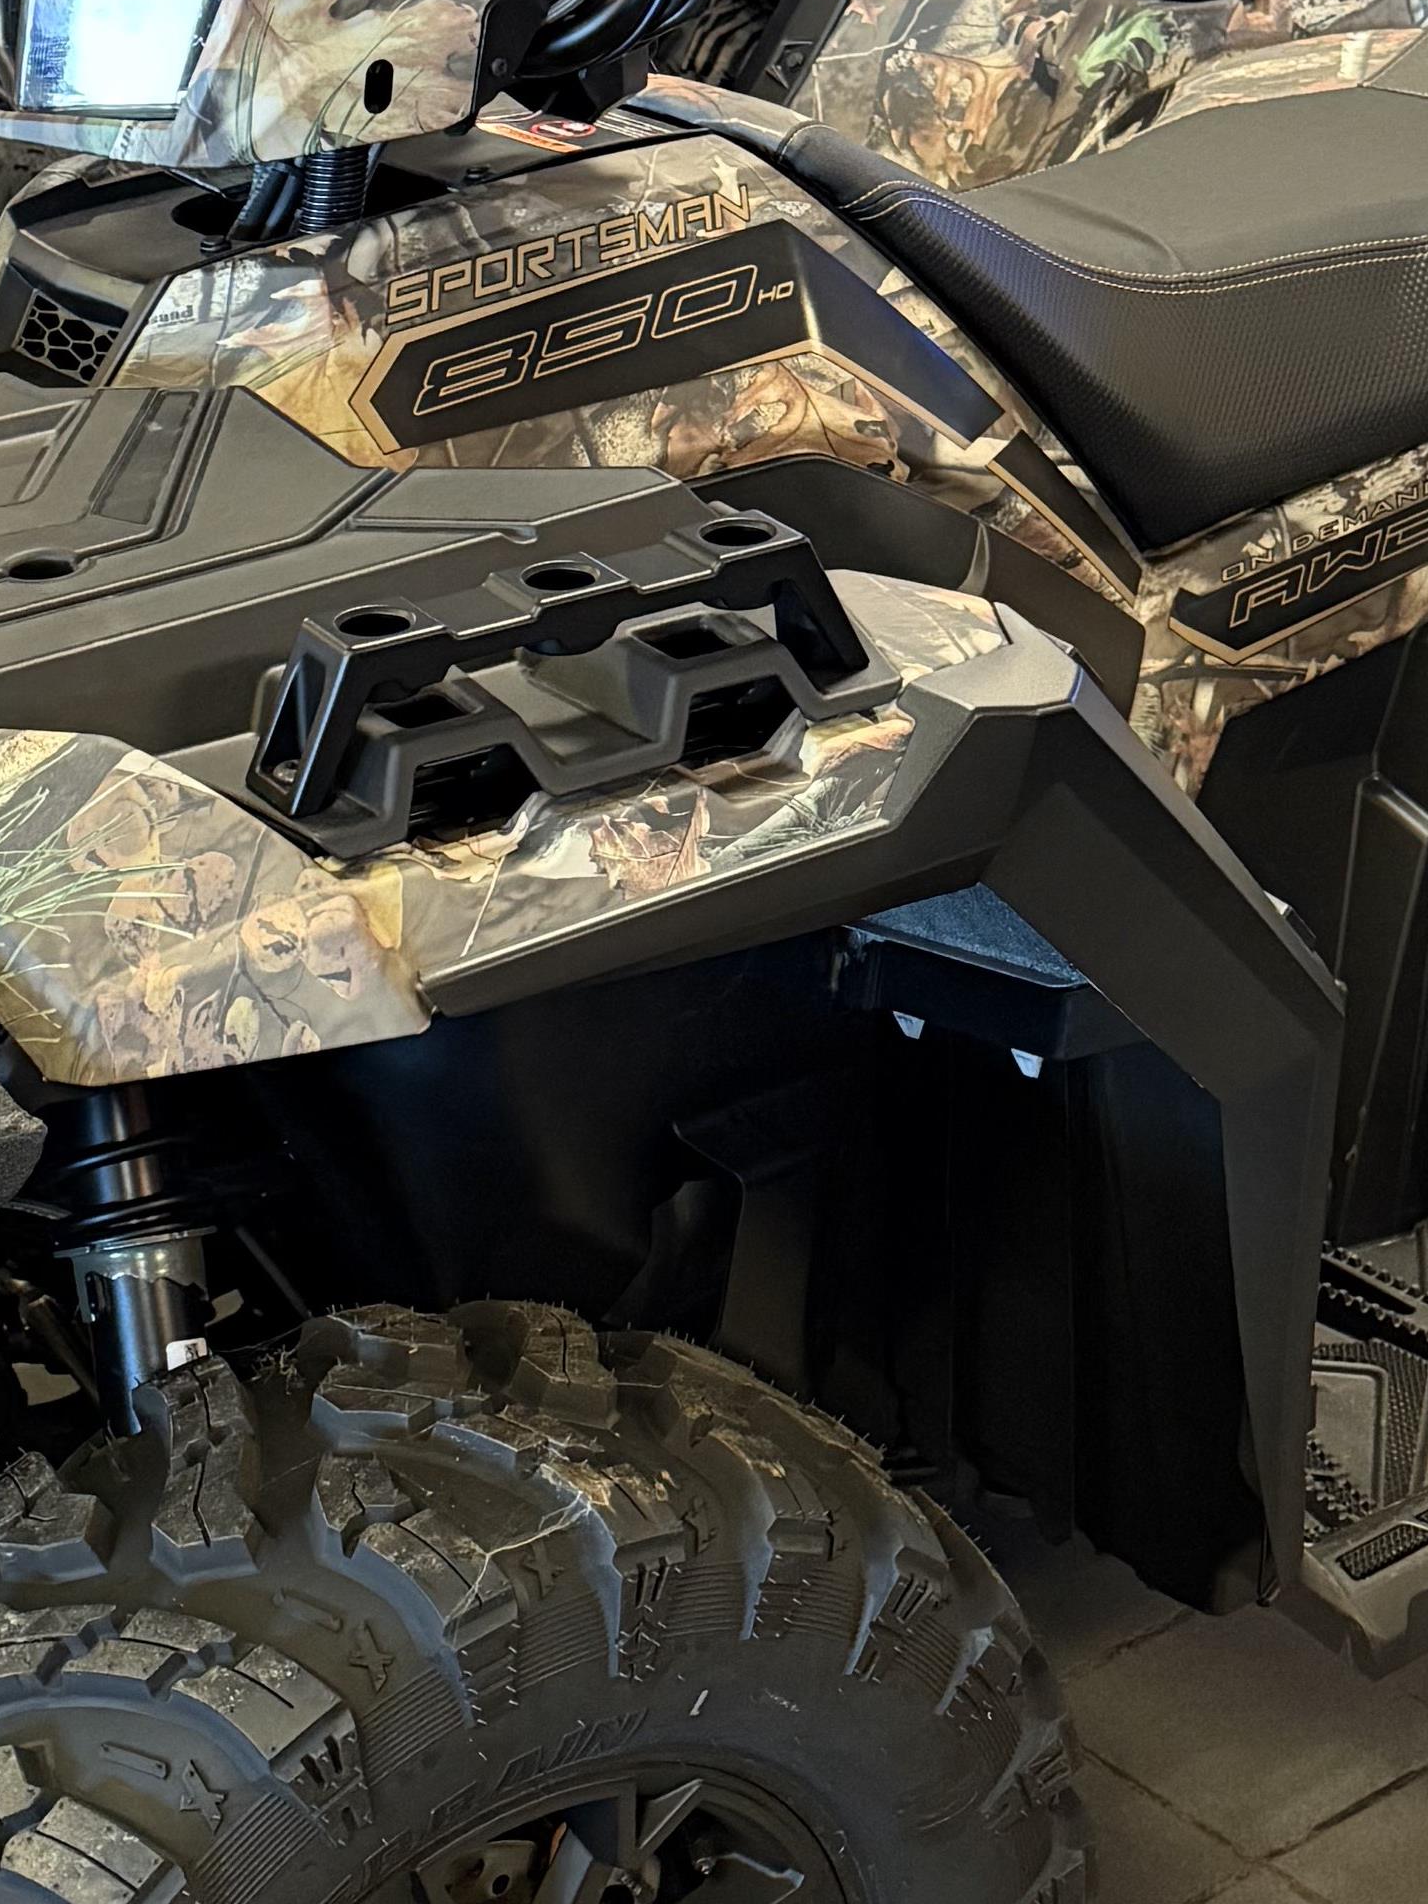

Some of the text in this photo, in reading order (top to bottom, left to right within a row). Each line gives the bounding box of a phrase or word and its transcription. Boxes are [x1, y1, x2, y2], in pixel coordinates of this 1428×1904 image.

[387, 183, 752, 325] SPORTSMAN
[412, 264, 795, 416] 850 HD
[1221, 552, 1276, 582] ON
